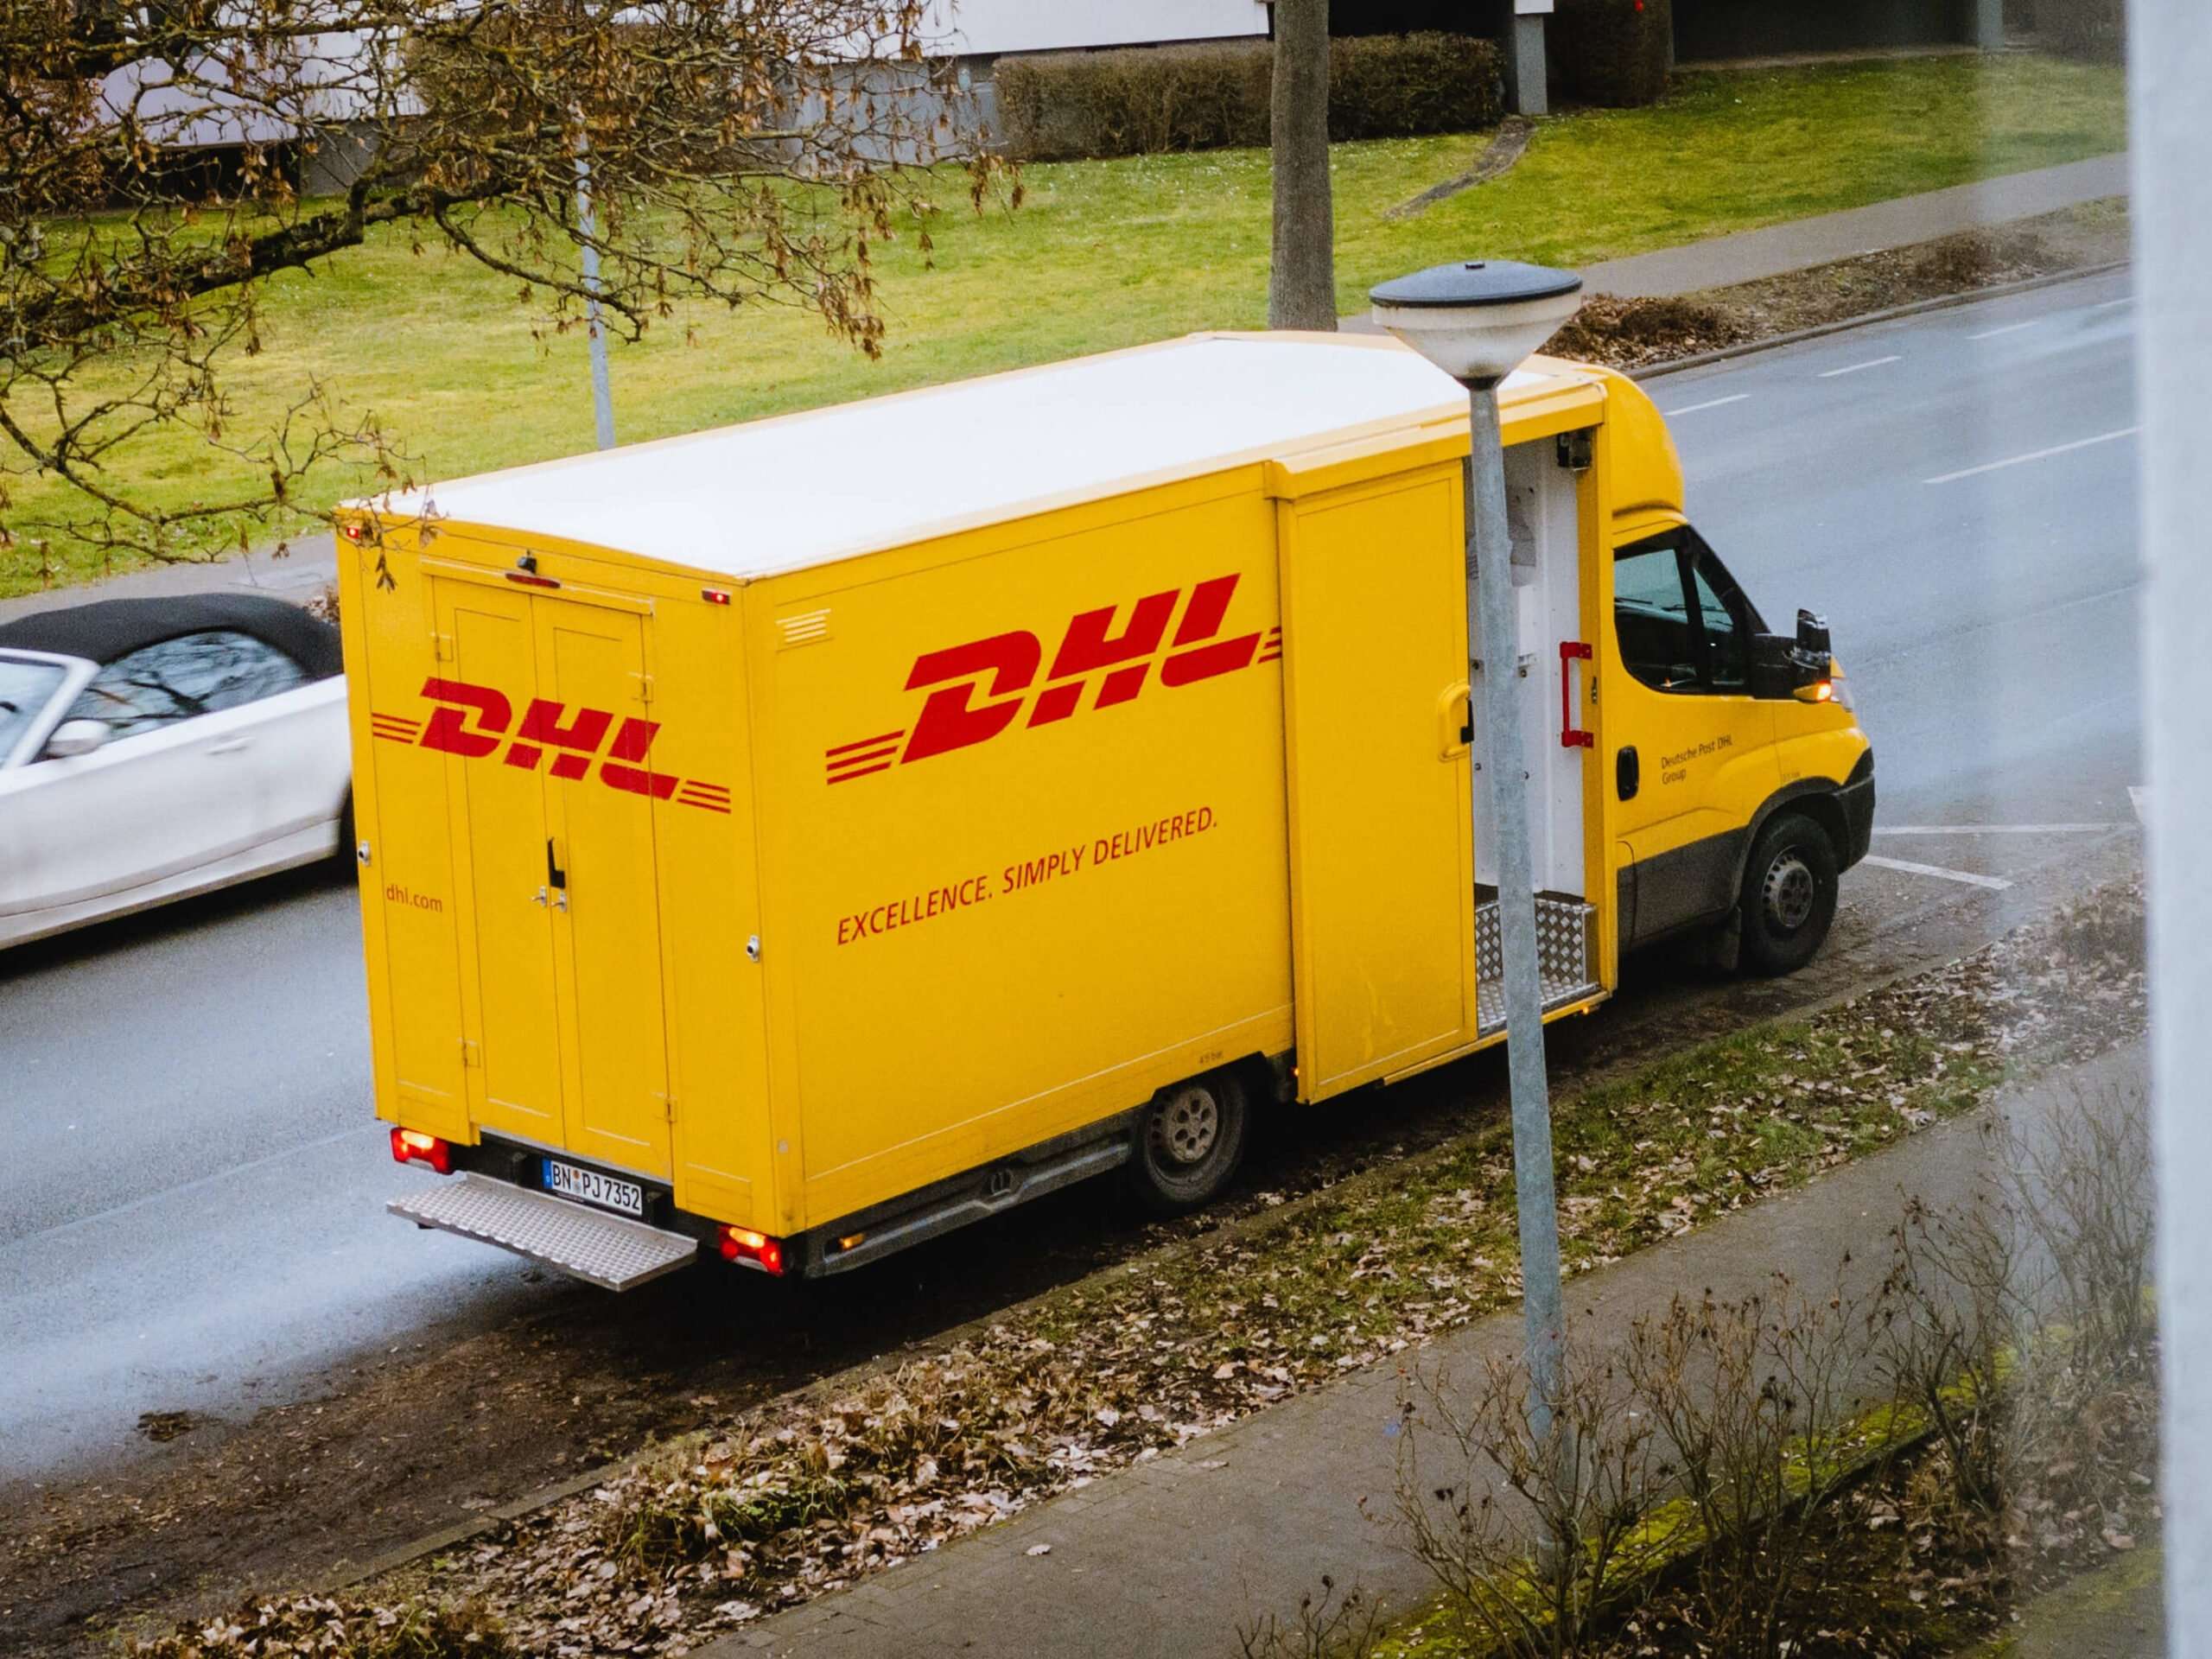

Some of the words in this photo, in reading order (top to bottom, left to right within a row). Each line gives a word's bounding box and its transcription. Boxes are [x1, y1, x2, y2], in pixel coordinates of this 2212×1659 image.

[899, 573, 1263, 766] DHL
[420, 677, 679, 800] DHL
[1662, 748, 1697, 768] Deutsche
[1699, 741, 1715, 754] Post
[1718, 734, 1732, 748] DHL
[1662, 768, 1687, 785] Group
[386, 884, 442, 912] dhl.com
[837, 875, 994, 946] EXCELLENCE.
[1002, 845, 1086, 894] SIMPLY
[1093, 806, 1218, 866] DELIVERED.
[553, 1166, 570, 1189] BN
[582, 1173, 600, 1198] PJ
[605, 1181, 639, 1210] 7352
